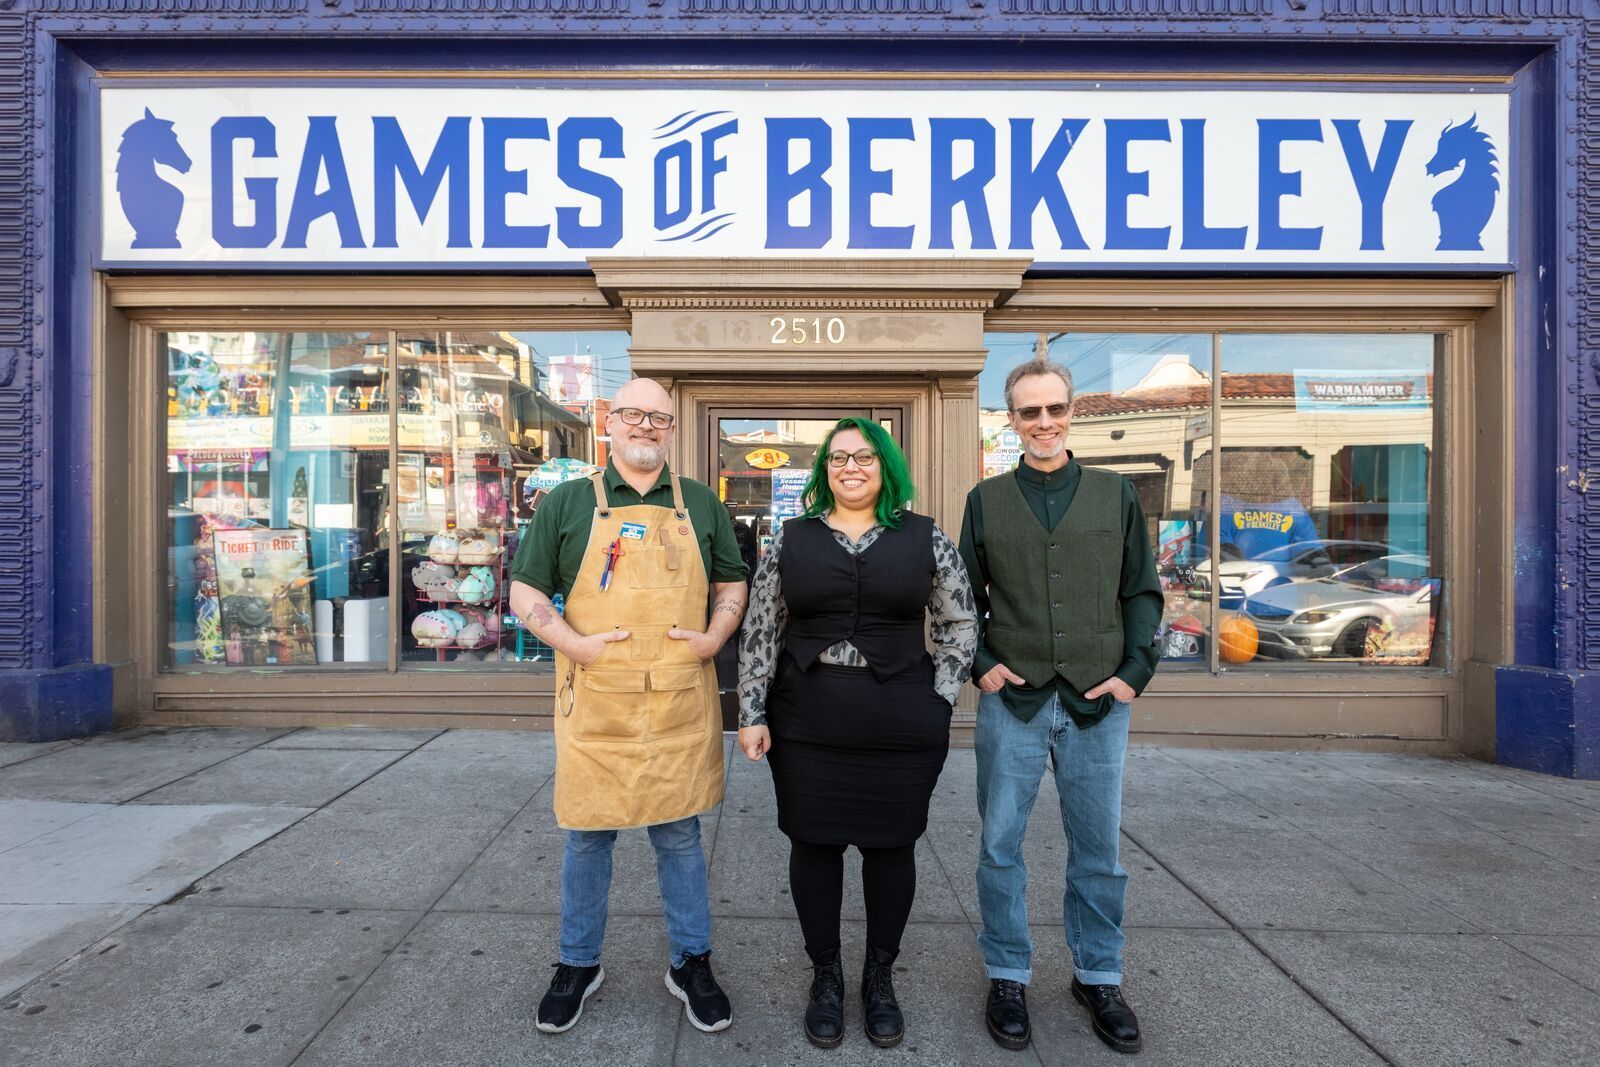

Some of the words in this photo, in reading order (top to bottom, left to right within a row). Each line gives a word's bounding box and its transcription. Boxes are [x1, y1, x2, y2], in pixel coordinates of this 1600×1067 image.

[211, 116, 625, 249] GAMES
[653, 117, 739, 231] OF
[764, 116, 1415, 251] BERKELEY
[770, 317, 845, 344] 2510
[1313, 384, 1405, 396] WARHAMMER
[1245, 511, 1283, 523] GAMES
[220, 541, 258, 554] TICKET
[261, 542, 271, 551] TO
[272, 538, 298, 551] RIDE
